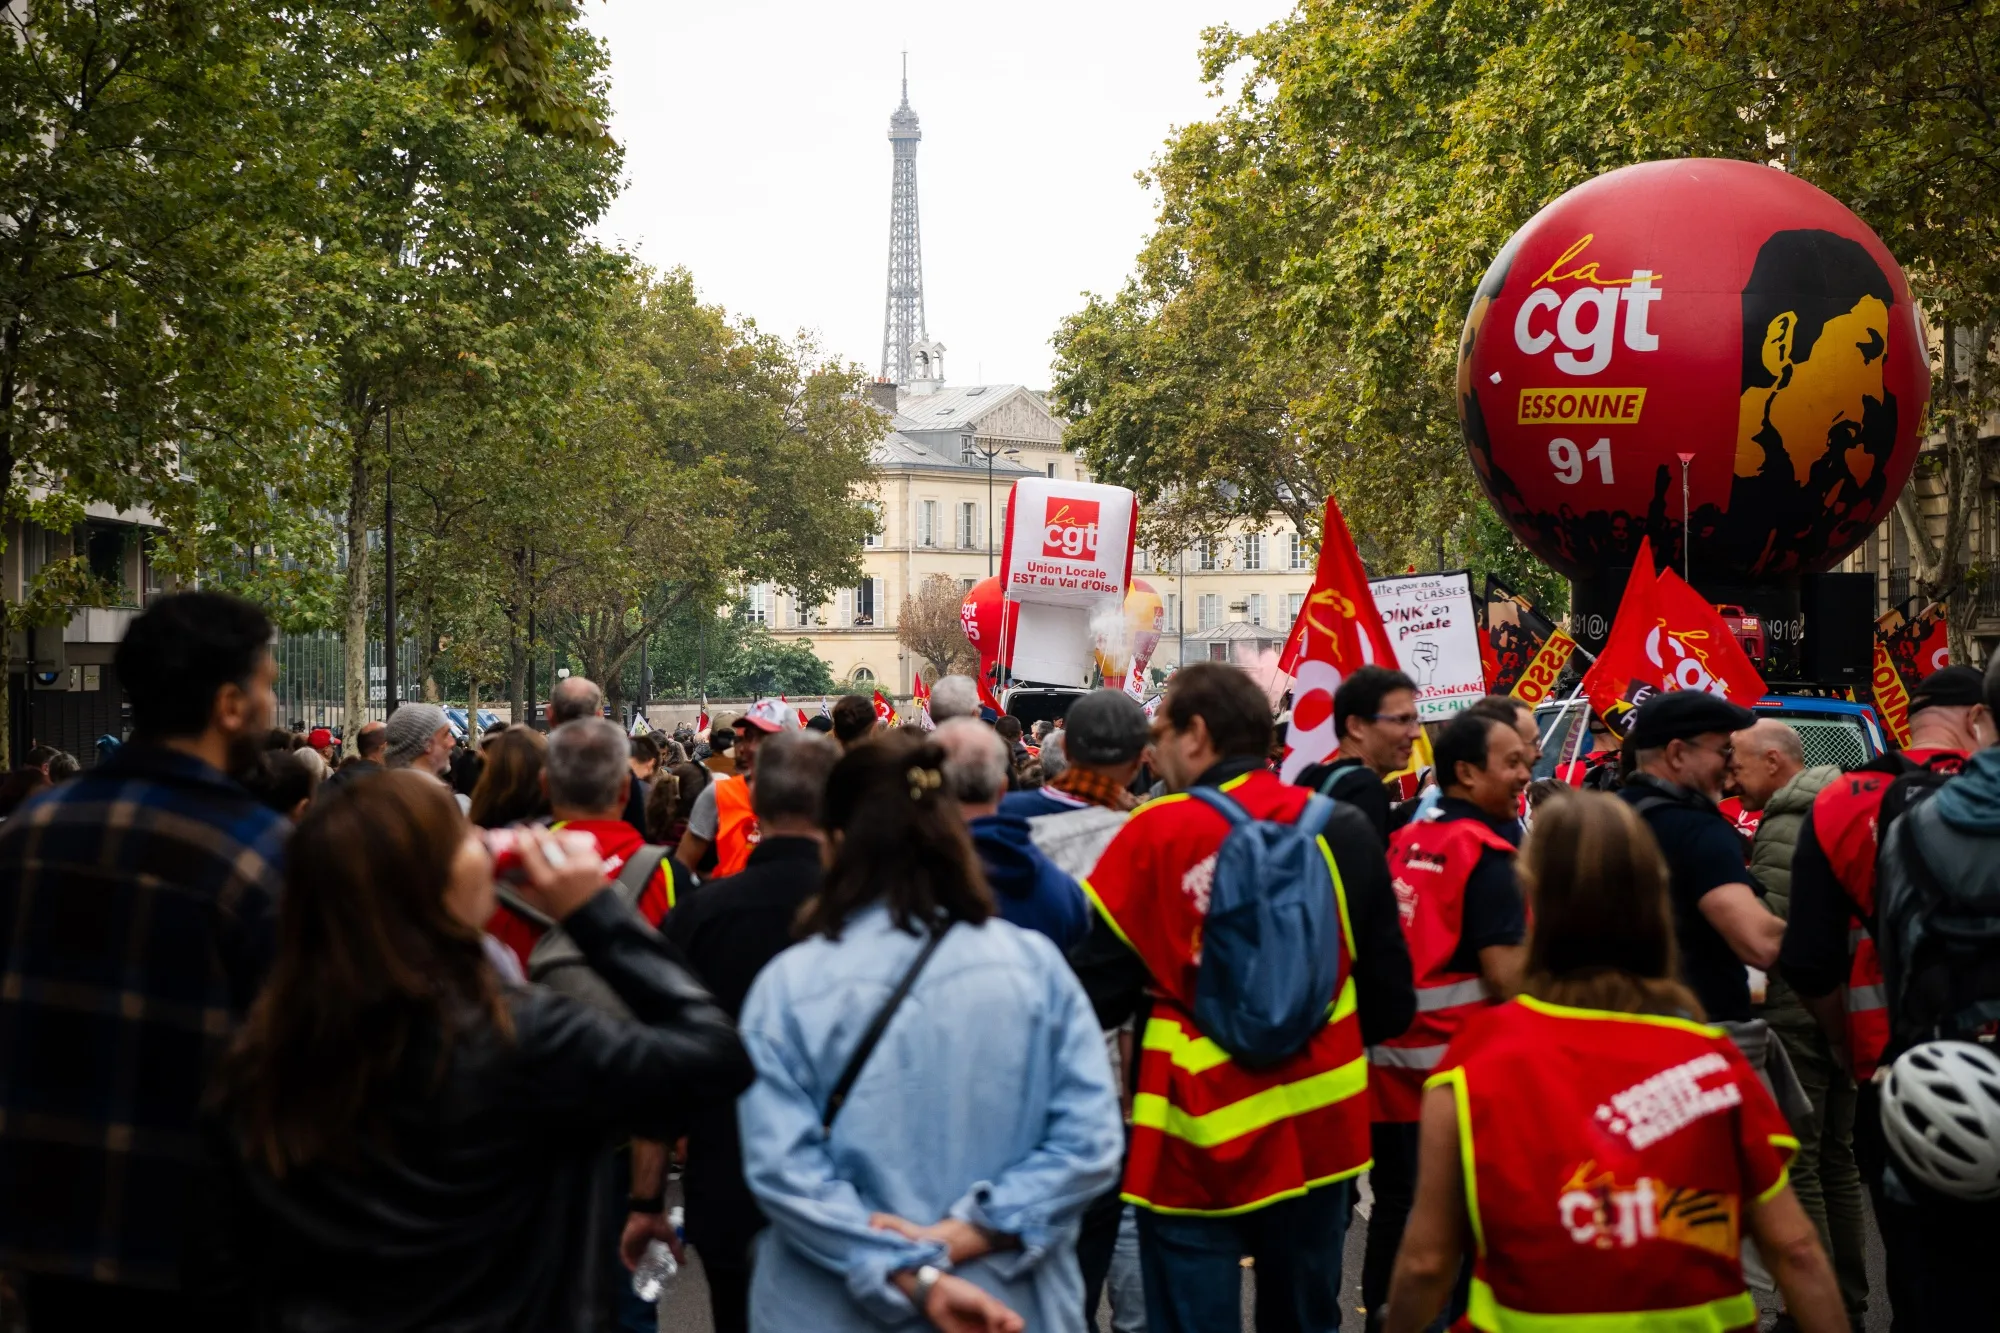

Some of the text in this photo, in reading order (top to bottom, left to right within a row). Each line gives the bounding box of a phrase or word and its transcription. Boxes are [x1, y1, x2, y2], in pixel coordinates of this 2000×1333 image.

[1531, 233, 1662, 288] la
[1514, 269, 1662, 376] cgt
[1521, 394, 1639, 419] ESSONNE
[1548, 438, 1615, 484] 91
[1047, 505, 1099, 527] la
[1043, 523, 1099, 556] cgt
[1027, 562, 1107, 579] Union Locale
[1013, 573, 1036, 585] EST
[1040, 576, 1055, 586] du
[1059, 577, 1077, 589] Val
[1370, 584, 1392, 596] utte
[1421, 580, 1441, 588] nos
[1415, 586, 1466, 601] CLASSES
[1432, 605, 1449, 616] en
[1742, 618, 1757, 626] cgt
[1420, 700, 1473, 713] ISEAU
